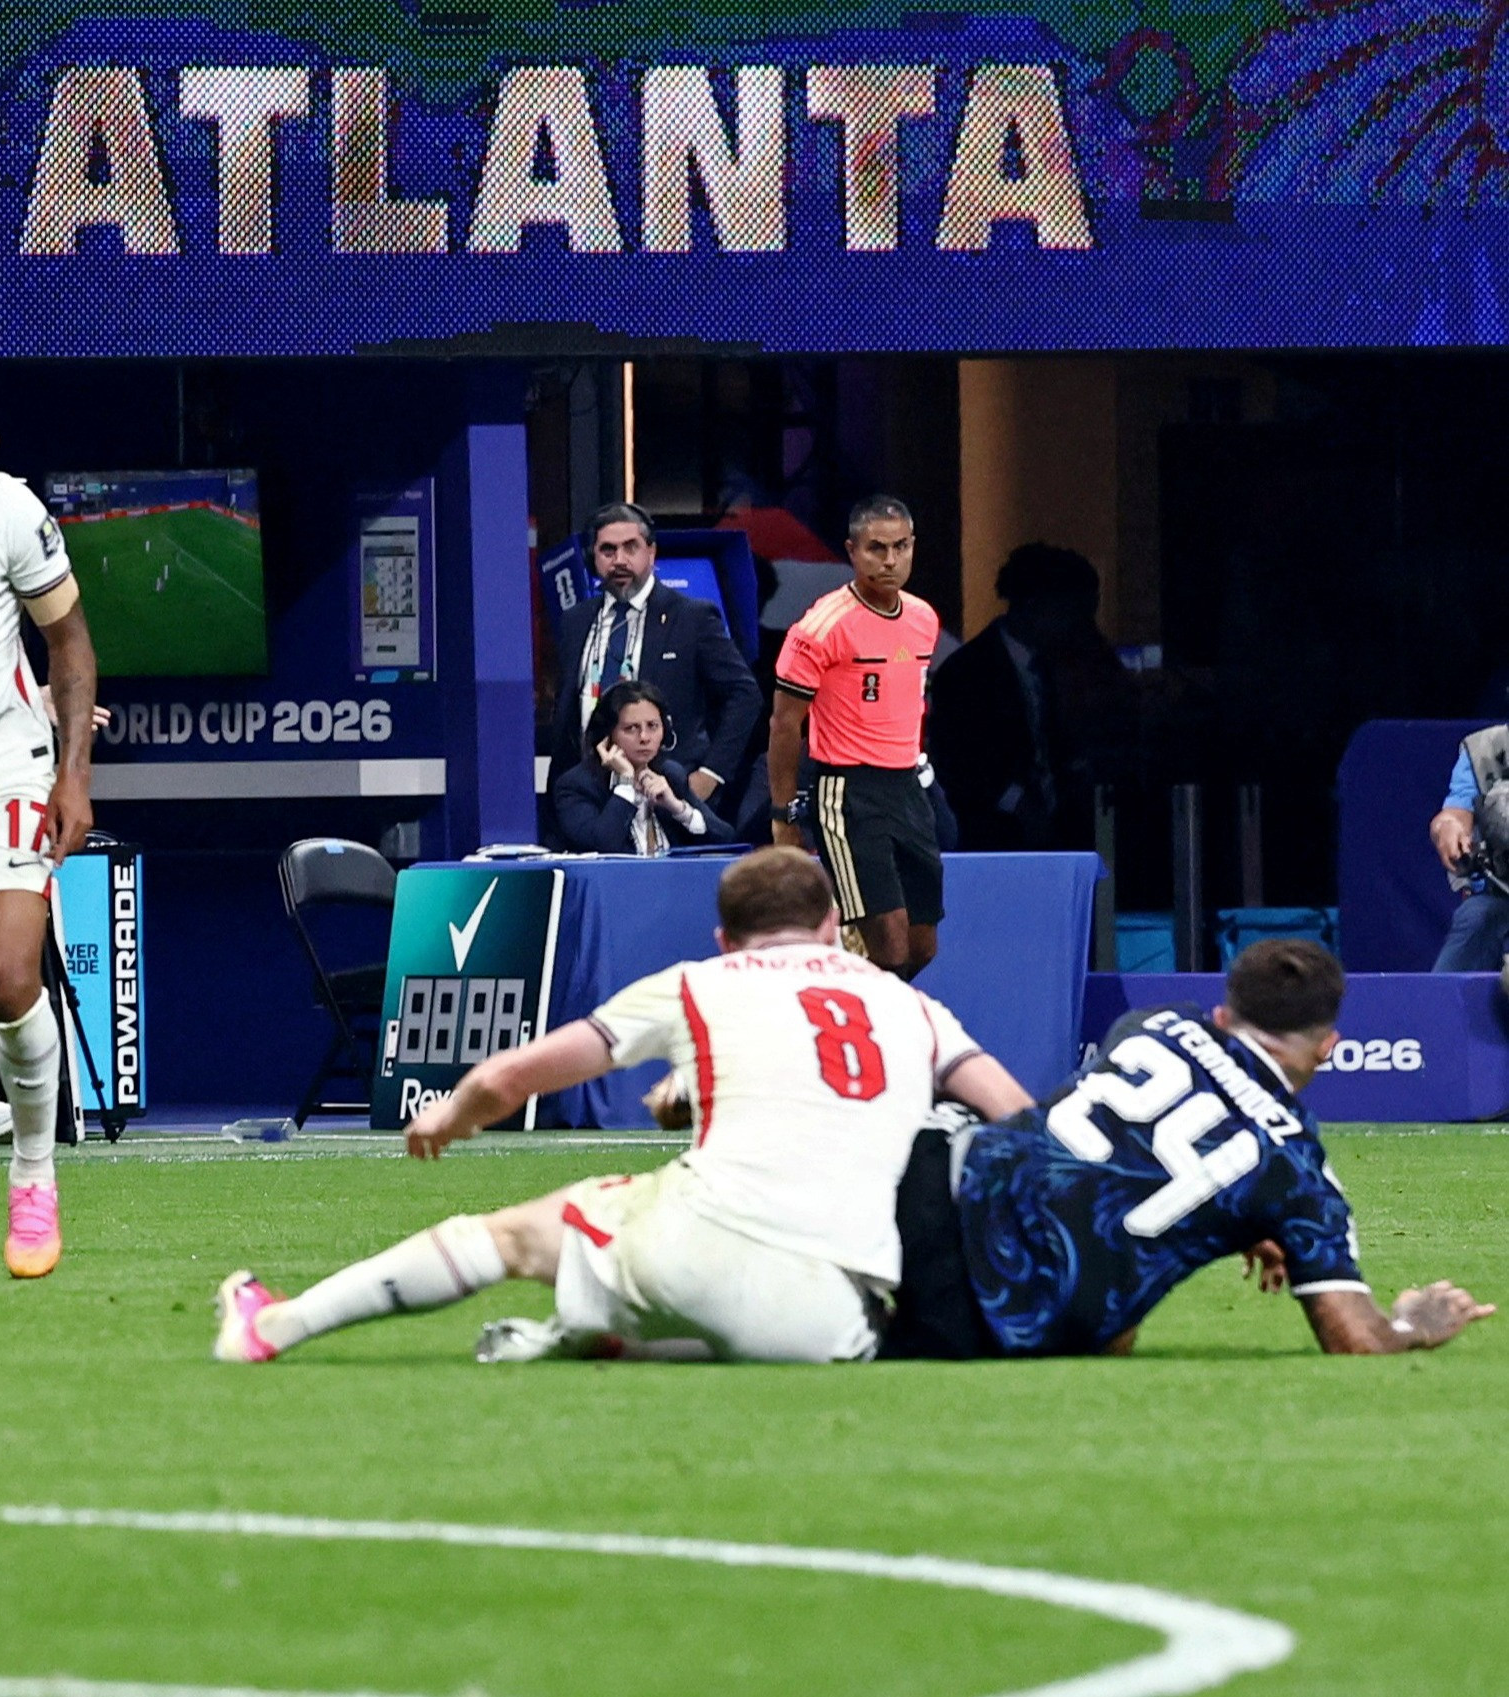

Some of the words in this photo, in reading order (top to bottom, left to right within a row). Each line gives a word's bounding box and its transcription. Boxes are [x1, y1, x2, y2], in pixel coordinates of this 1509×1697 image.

[20, 65, 1093, 255] ATLANTA
[102, 702, 193, 744] ORLD
[199, 702, 267, 744] CUP
[272, 699, 393, 743] 2026
[5, 798, 48, 853] 17
[114, 863, 139, 1105] POWERADE
[797, 986, 887, 1102] 8
[1047, 1034, 1260, 1238] 24
